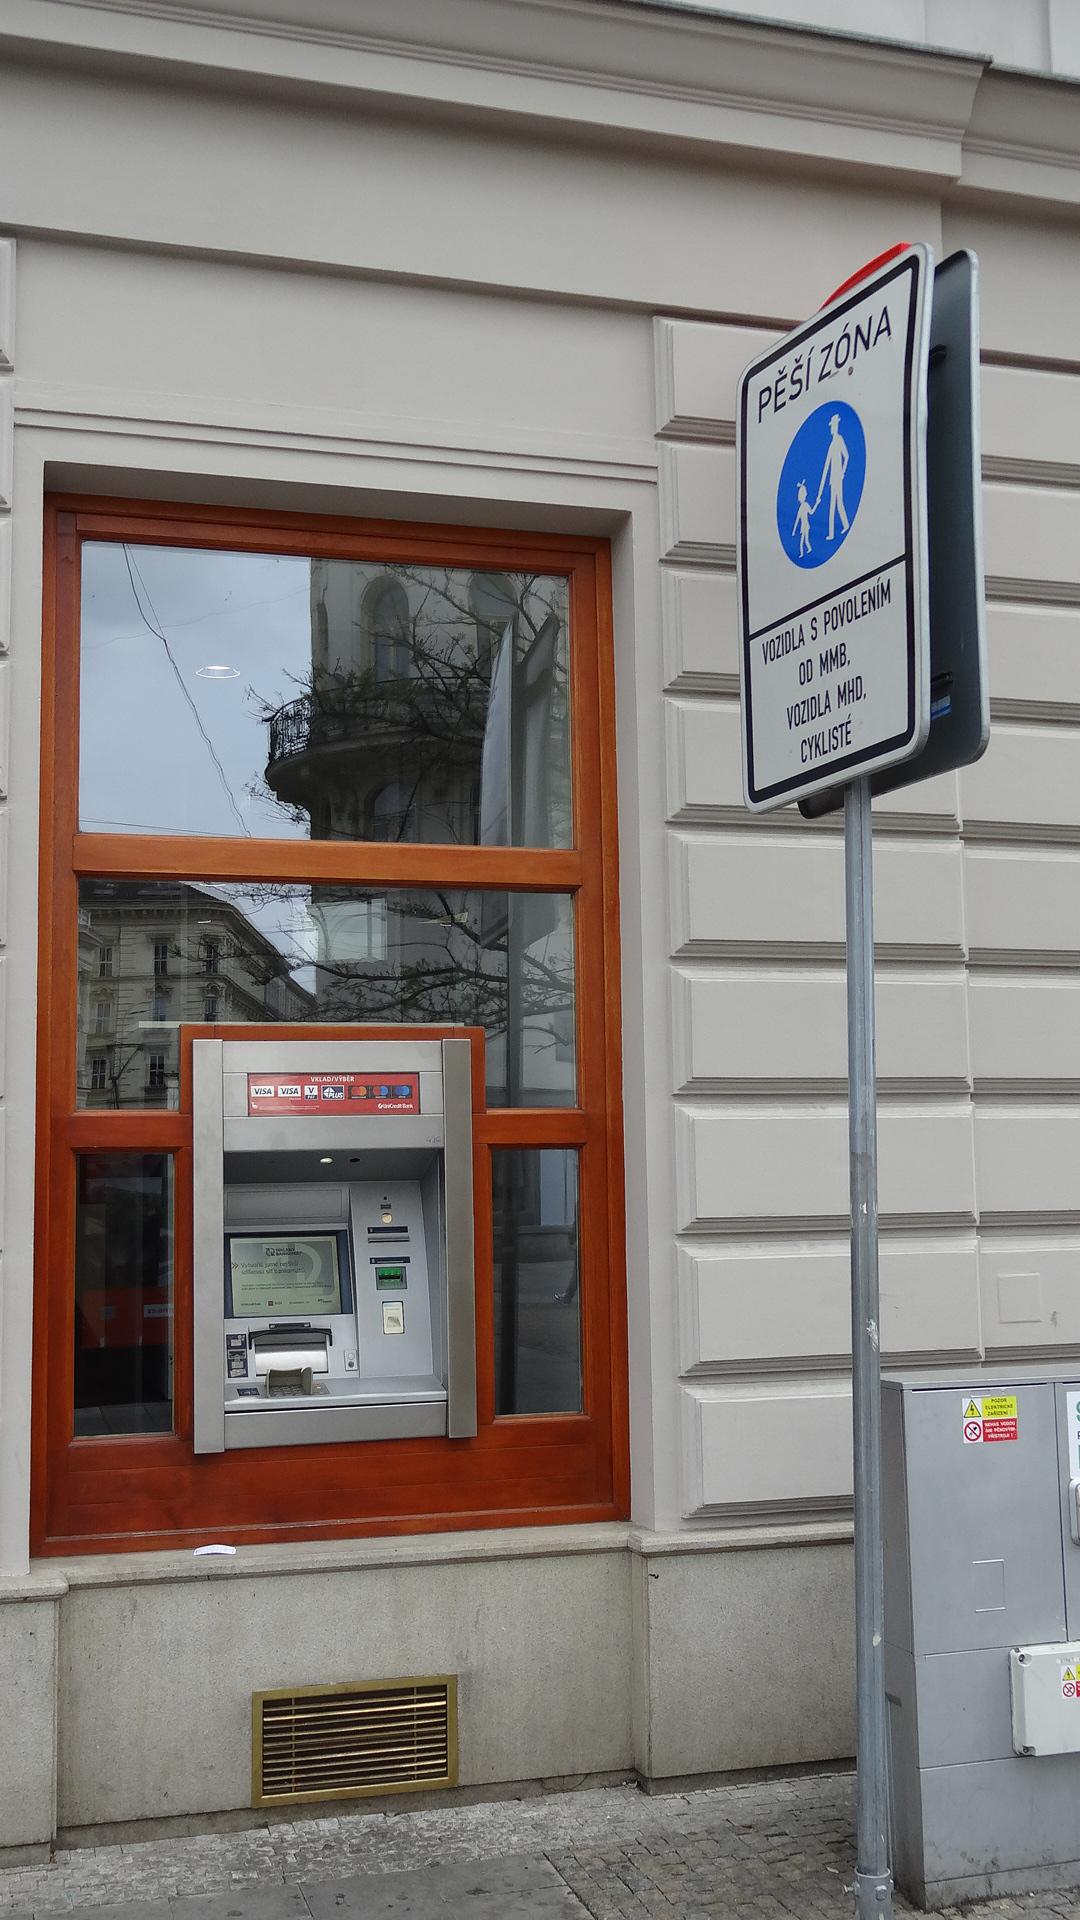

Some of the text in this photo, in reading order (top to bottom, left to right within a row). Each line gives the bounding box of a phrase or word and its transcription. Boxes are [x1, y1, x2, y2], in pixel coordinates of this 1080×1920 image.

[758, 305, 891, 424] PĚŠÍ ZÓNA
[762, 577, 892, 664] VOZIDLA S POVOLENÍM
[799, 643, 851, 686] OD MMB,
[787, 675, 867, 730] VOZIDLA MHD,
[801, 713, 852, 763] CYKLISTÉ
[254, 1087, 273, 1095] VISA
[280, 1087, 299, 1095] VISA
[310, 1075, 355, 1083] VKLAD/VÝBĚR
[328, 1091, 344, 1099] PLUS
